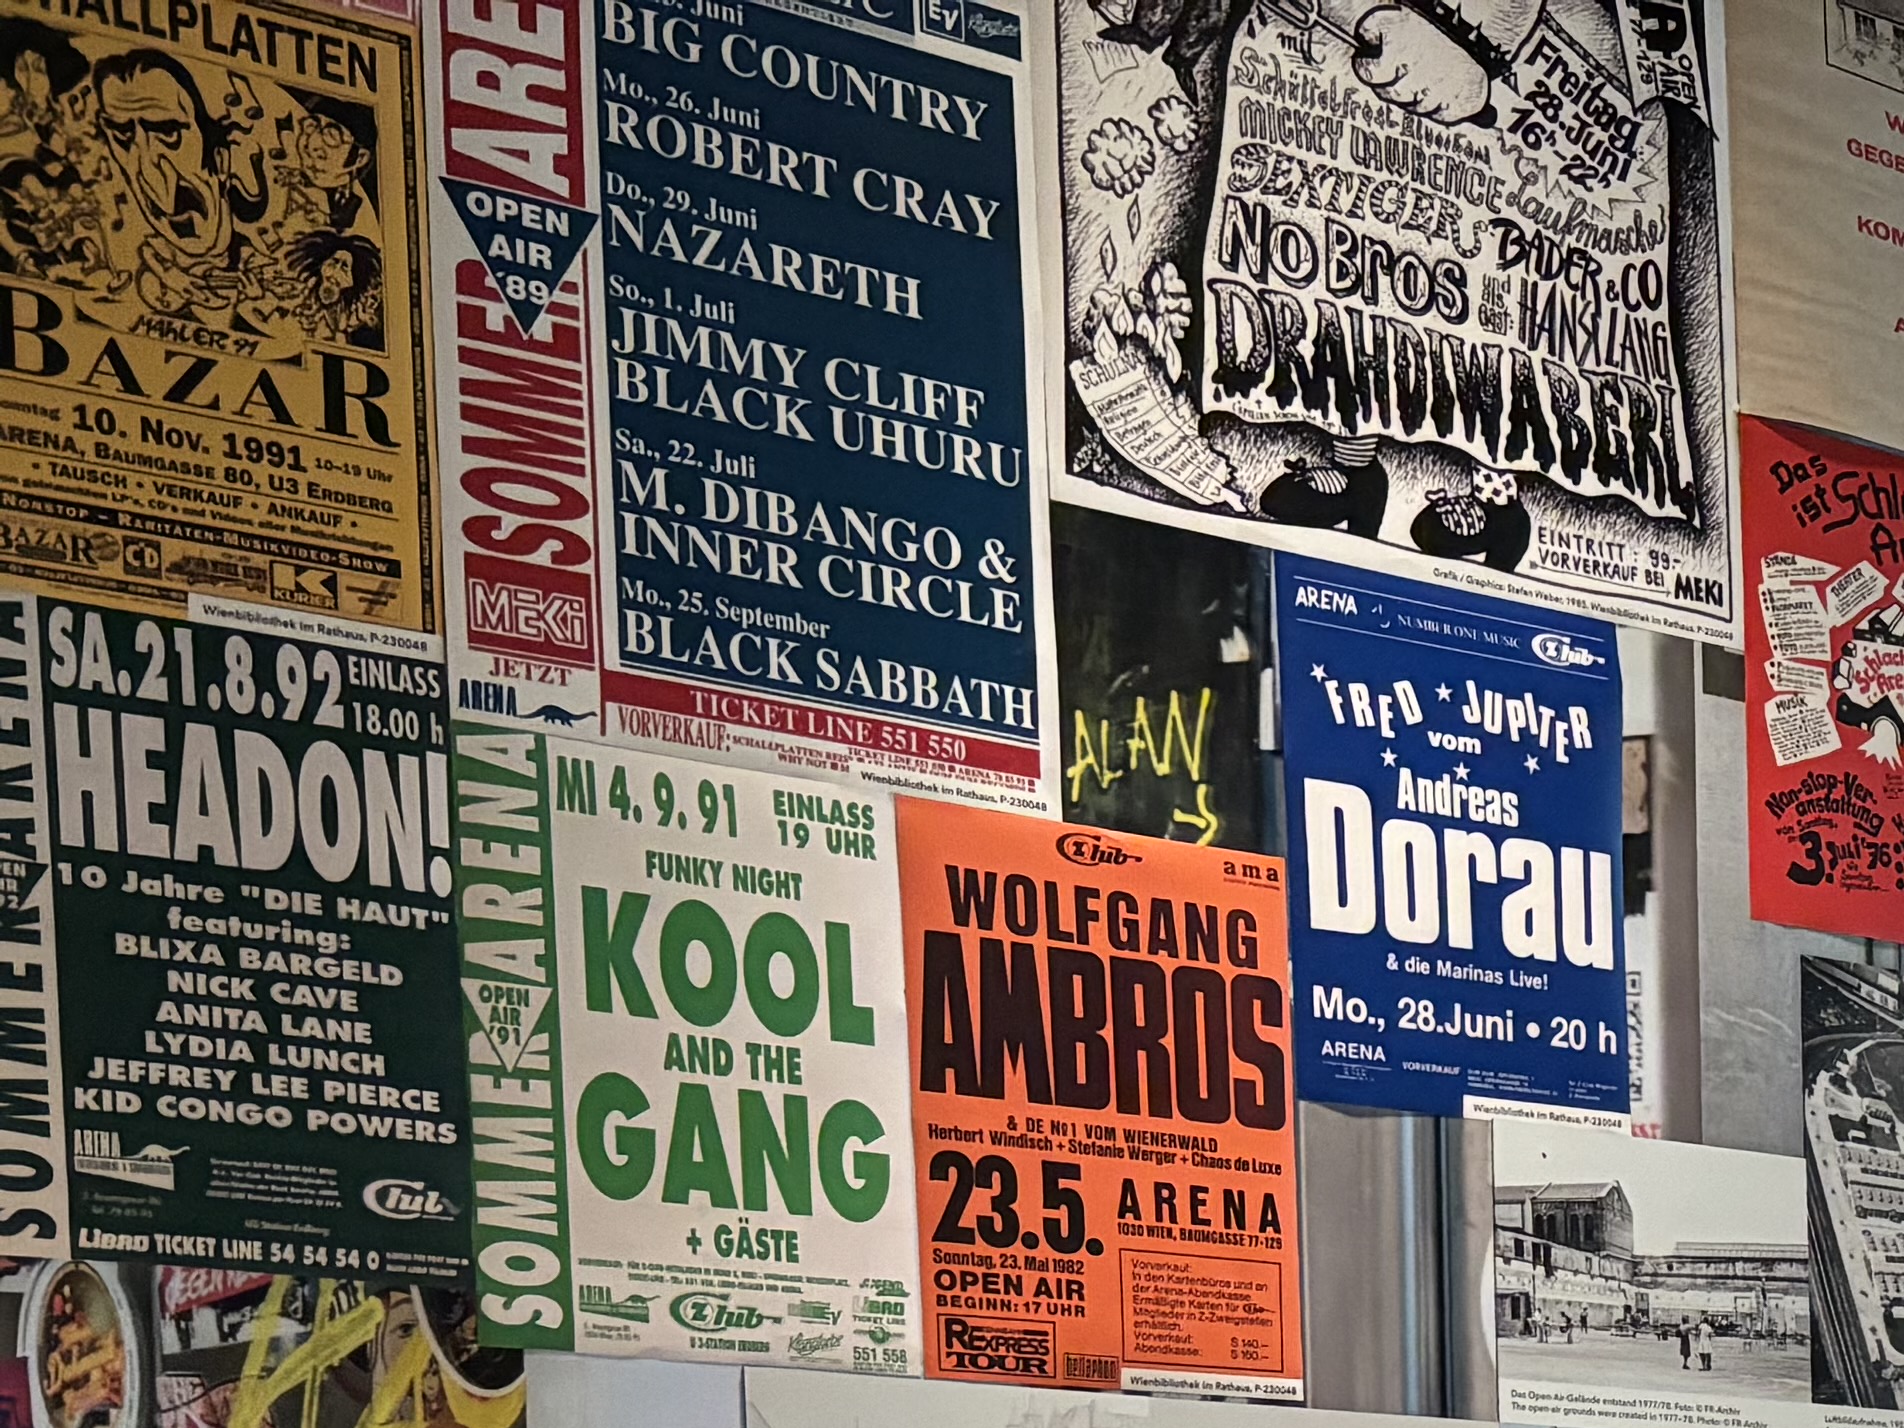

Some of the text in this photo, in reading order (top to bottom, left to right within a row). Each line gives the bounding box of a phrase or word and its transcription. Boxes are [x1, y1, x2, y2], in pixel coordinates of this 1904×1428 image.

[602, 7, 989, 141] BIG COUNTRY
[1523, 35, 1641, 153] Freitag
[604, 99, 1001, 240] ROBERT CRAY
[1237, 96, 1506, 214] MICKEY LAWRENCE
[466, 191, 570, 237] OPEN
[488, 233, 553, 271] AIR
[607, 203, 923, 320] NAZARETH
[1488, 217, 1602, 300] BADER
[1620, 259, 1663, 312] CO
[0, 283, 402, 448] BAZAR
[611, 306, 985, 429] JIMMY CLIFF
[1207, 278, 1698, 522] DRAHDIWABERL
[71, 403, 309, 474] 10. Nov. 1991
[614, 357, 1022, 488] BLACK UHURU
[1768, 456, 1830, 493] Das
[619, 511, 1023, 634] INNER CIRCLE
[1294, 585, 1358, 615] ARENA
[1672, 572, 1725, 609] MEKI
[347, 654, 441, 699] EINLASS
[623, 608, 1036, 730] BLACK SABBATH
[1324, 679, 1423, 739] FRED
[1066, 687, 1211, 803] ALAN
[1427, 730, 1482, 755] vom
[1461, 679, 1593, 764] JUPITER
[53, 701, 453, 898] HEADON!
[772, 789, 875, 831] EINLASS
[1397, 767, 1519, 828] Andreas
[457, 731, 546, 980] ARENA
[645, 849, 803, 902] FUNKY NIGHT
[1303, 777, 1614, 971] Dorau
[115, 932, 404, 987] BLIXA BARGELD
[944, 863, 1259, 970] WOLFGANG
[167, 969, 359, 1012] NICK CAVE
[580, 884, 876, 1047] KOOL
[144, 1030, 386, 1077] LYDIA LUNCH
[155, 1000, 373, 1045] ANITA LANE
[663, 1031, 803, 1086] AND THE
[919, 929, 1287, 1132] AMBROS
[1312, 984, 1617, 1055] Mo., 28.Juni 20 h
[468, 1030, 567, 1333] SOMMER
[575, 1071, 891, 1223] GANG
[928, 1149, 1105, 1257] 23.5.
[1117, 1177, 1282, 1235] ARENA
[933, 1268, 1086, 1302] OPEN AIR
